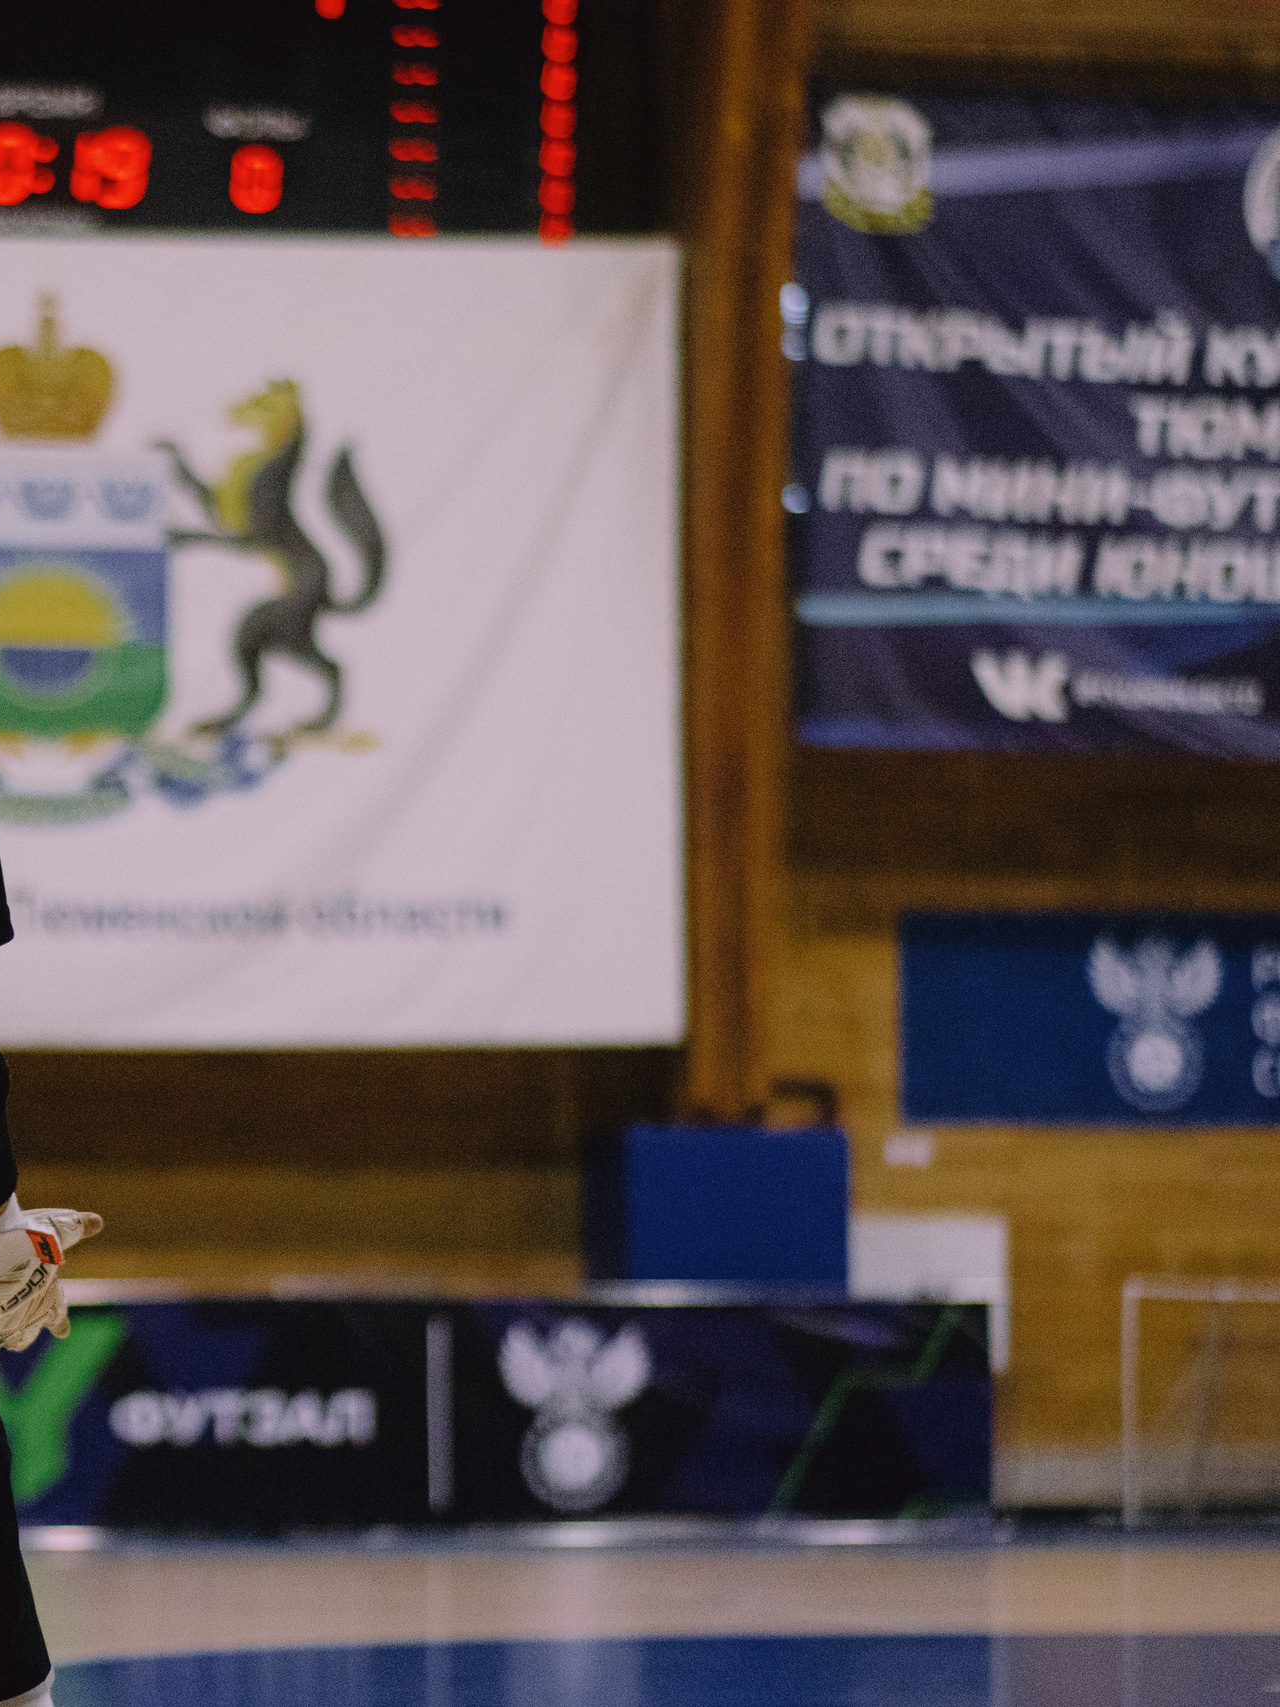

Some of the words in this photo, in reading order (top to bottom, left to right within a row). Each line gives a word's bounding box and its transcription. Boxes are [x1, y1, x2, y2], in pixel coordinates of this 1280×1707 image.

[812, 303, 1194, 386] ОТКРЫТЫЙ
[820, 447, 923, 515] ПО
[859, 523, 1084, 601] СРЕДИ
[108, 1387, 377, 1448] ФУТЗАЛ
